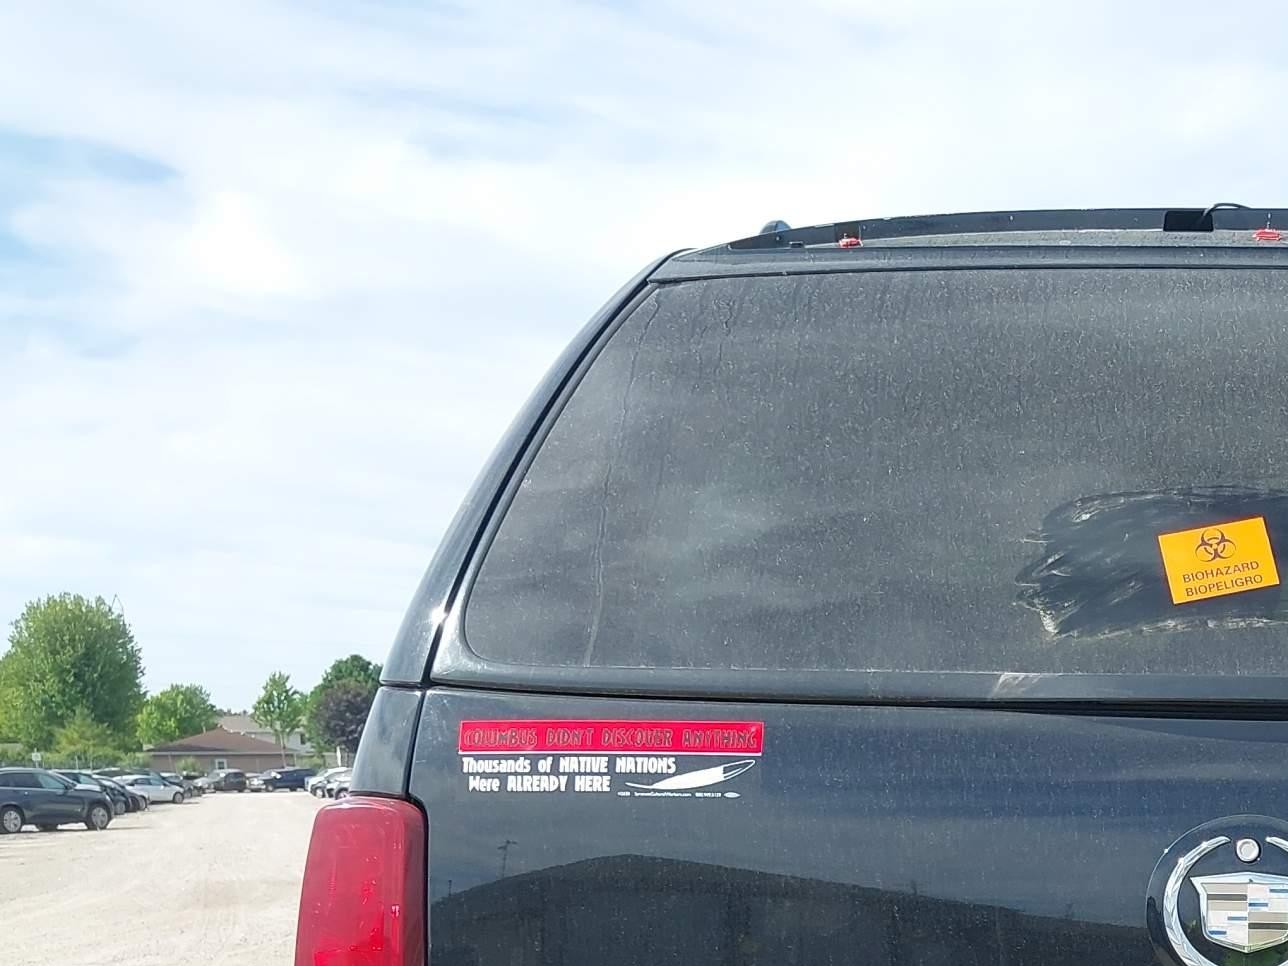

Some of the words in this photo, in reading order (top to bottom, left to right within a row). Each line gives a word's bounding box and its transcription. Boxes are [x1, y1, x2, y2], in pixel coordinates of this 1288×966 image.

[1182, 561, 1259, 583] BIOHAZARD
[1185, 574, 1263, 597] BIOPELIGRO
[463, 727, 538, 746] COLUMBUS
[601, 727, 674, 747] DISCOVER
[682, 728, 758, 749] ANYTHING
[462, 757, 531, 773] Thousands
[537, 757, 554, 773] of
[559, 756, 609, 773] NATIVE
[615, 757, 677, 774] NATIONS
[468, 775, 500, 792] Were
[506, 775, 569, 792] ALREADY
[574, 775, 611, 792] HERE
